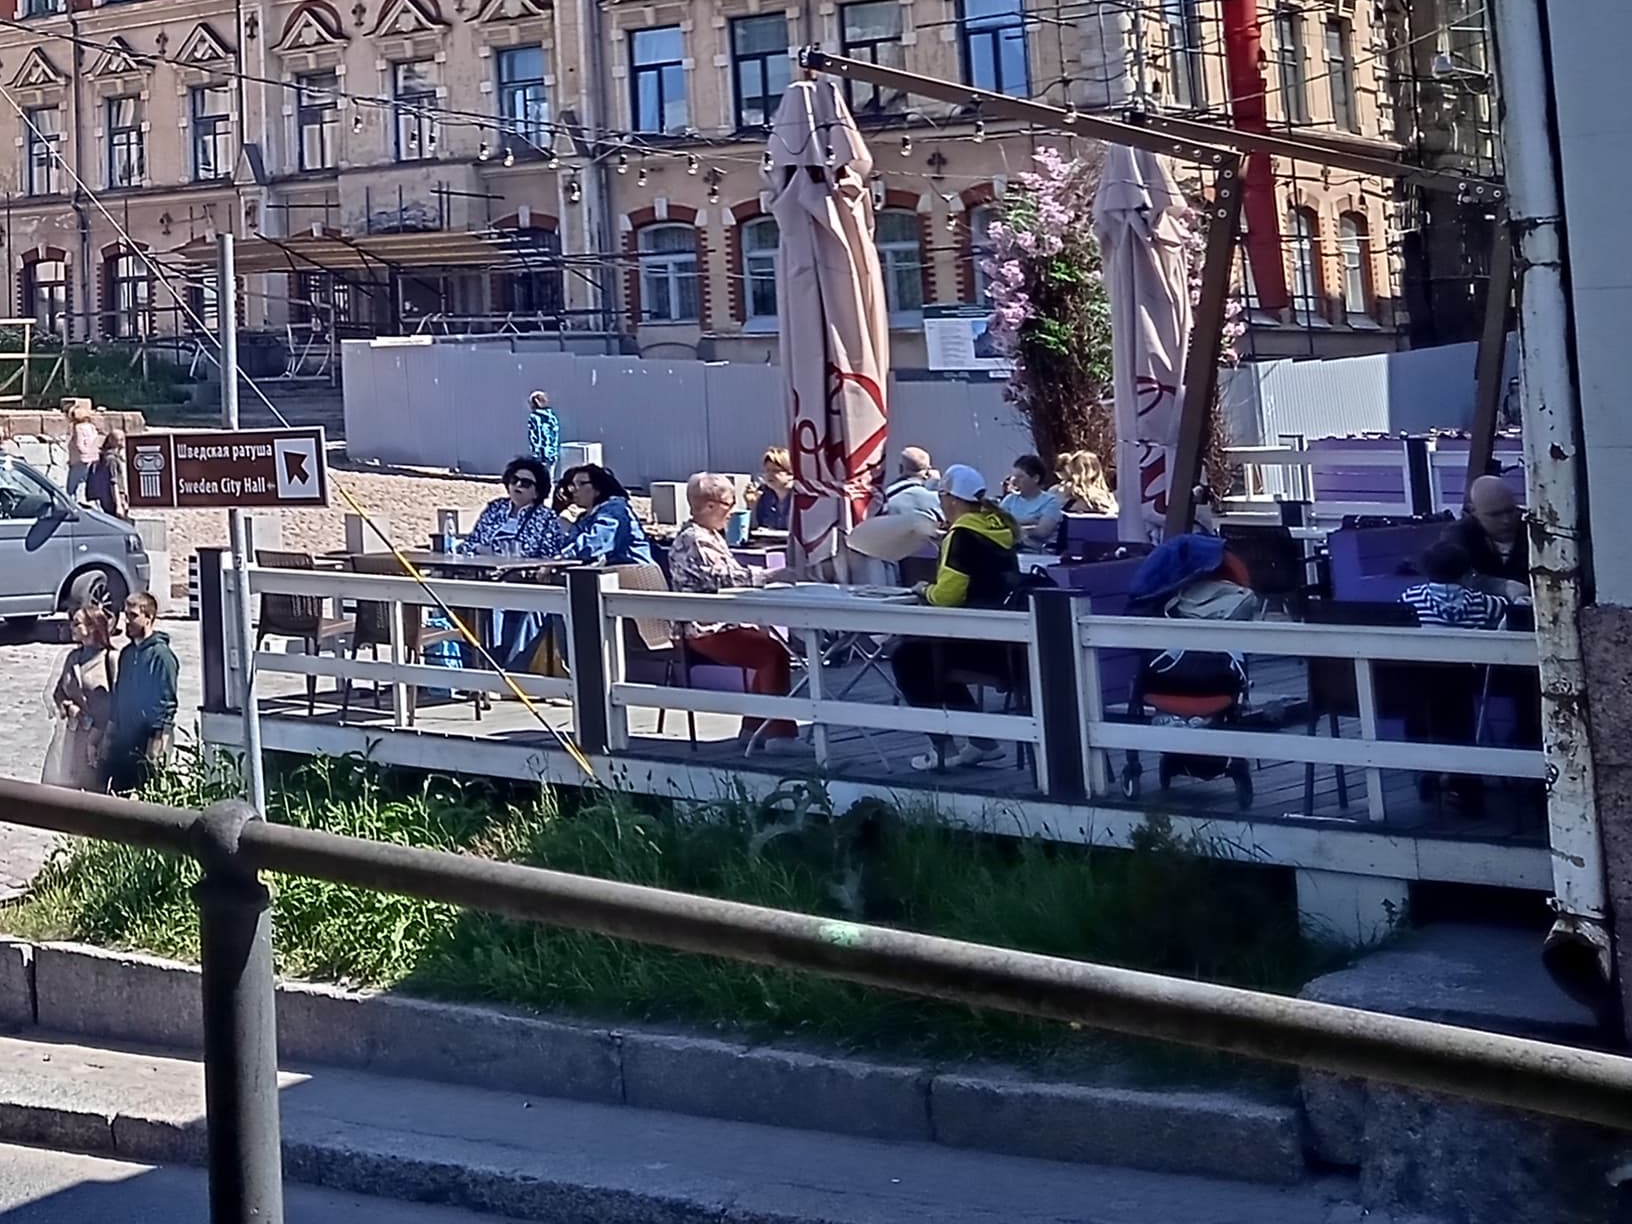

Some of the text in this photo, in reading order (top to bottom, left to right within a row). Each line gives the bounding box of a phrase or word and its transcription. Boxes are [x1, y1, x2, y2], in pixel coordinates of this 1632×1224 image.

[176, 443, 273, 461] Шведская ратуша
[178, 477, 266, 495] Sweden City Hall
